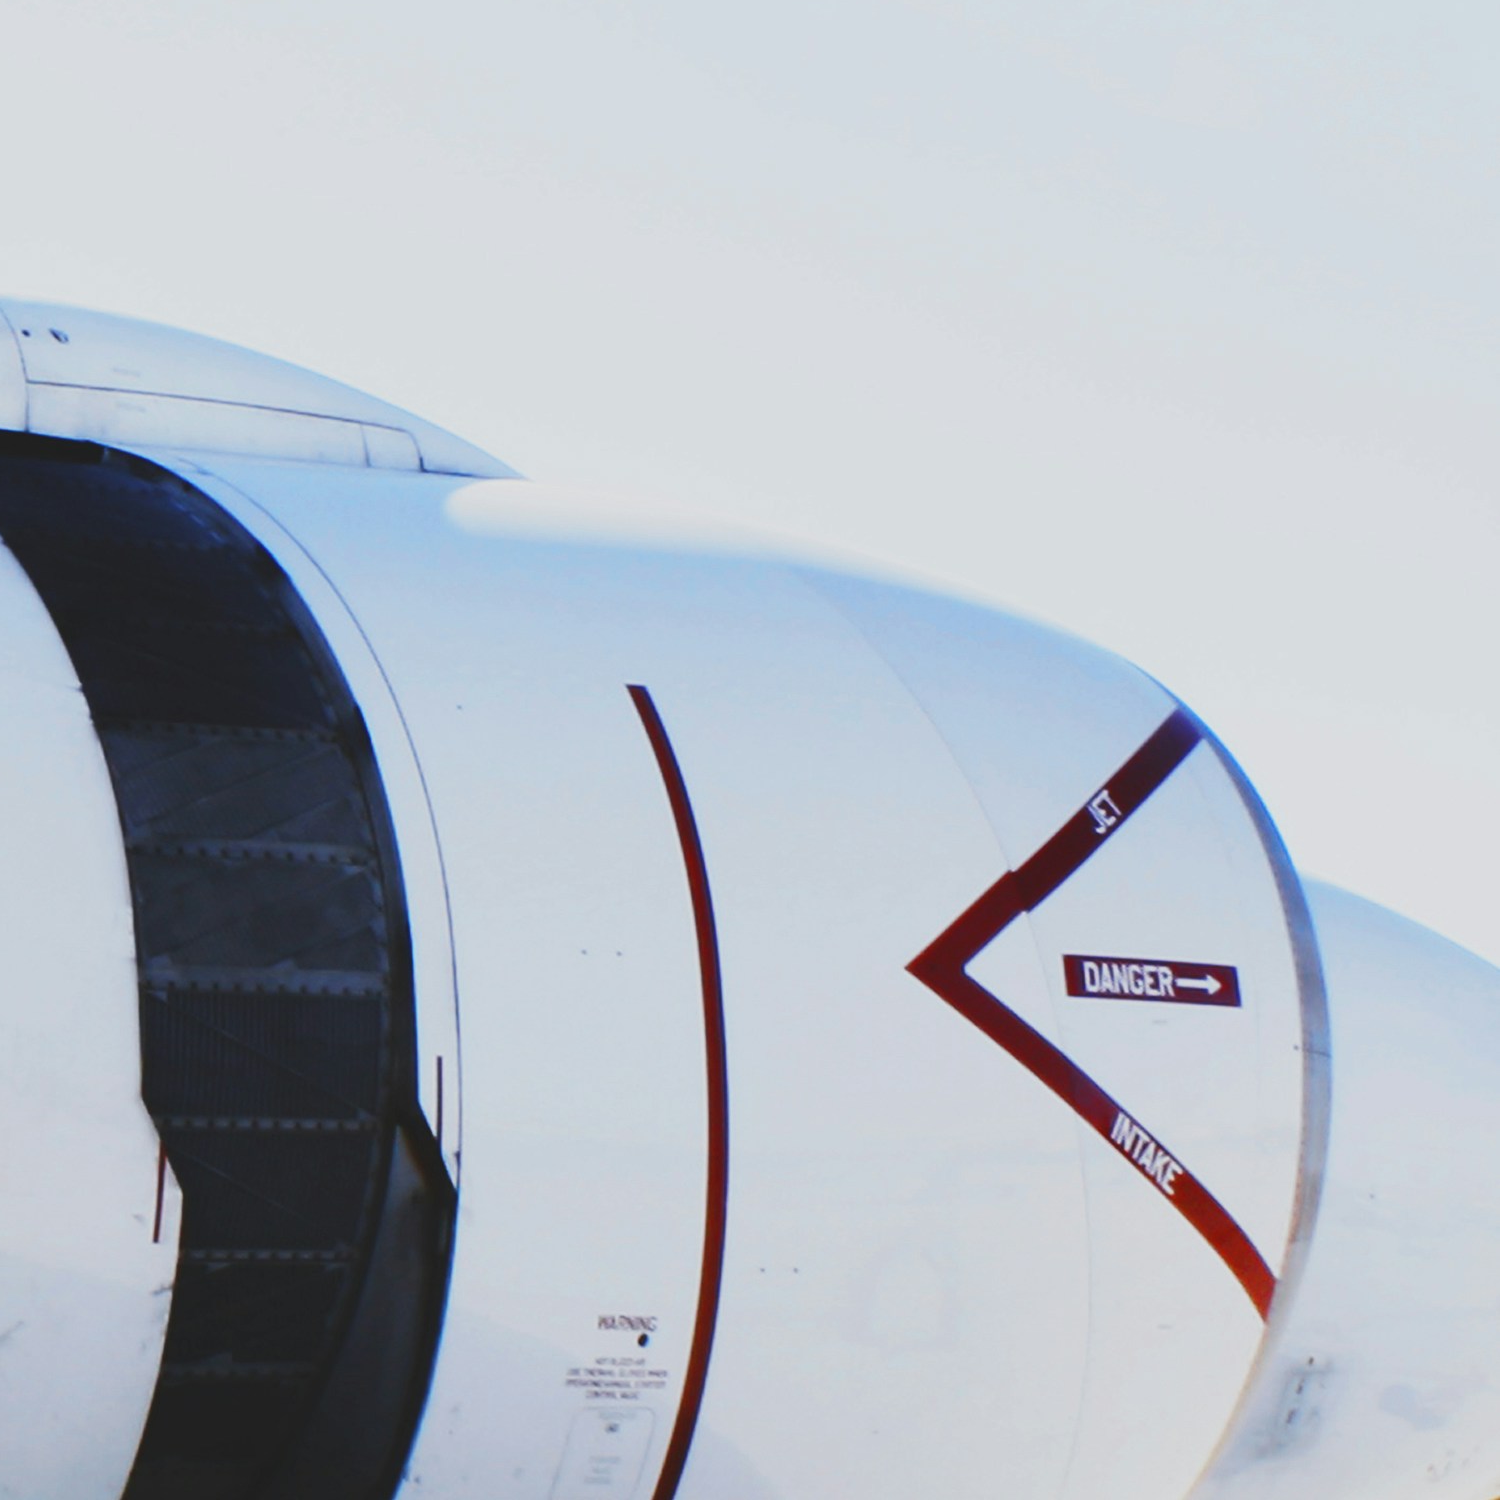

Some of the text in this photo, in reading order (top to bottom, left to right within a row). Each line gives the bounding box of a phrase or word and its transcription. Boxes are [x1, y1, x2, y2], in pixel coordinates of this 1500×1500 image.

[1086, 789, 1122, 834] JET
[1082, 960, 1176, 998] DANGER
[1109, 1111, 1184, 1196] INTAKE
